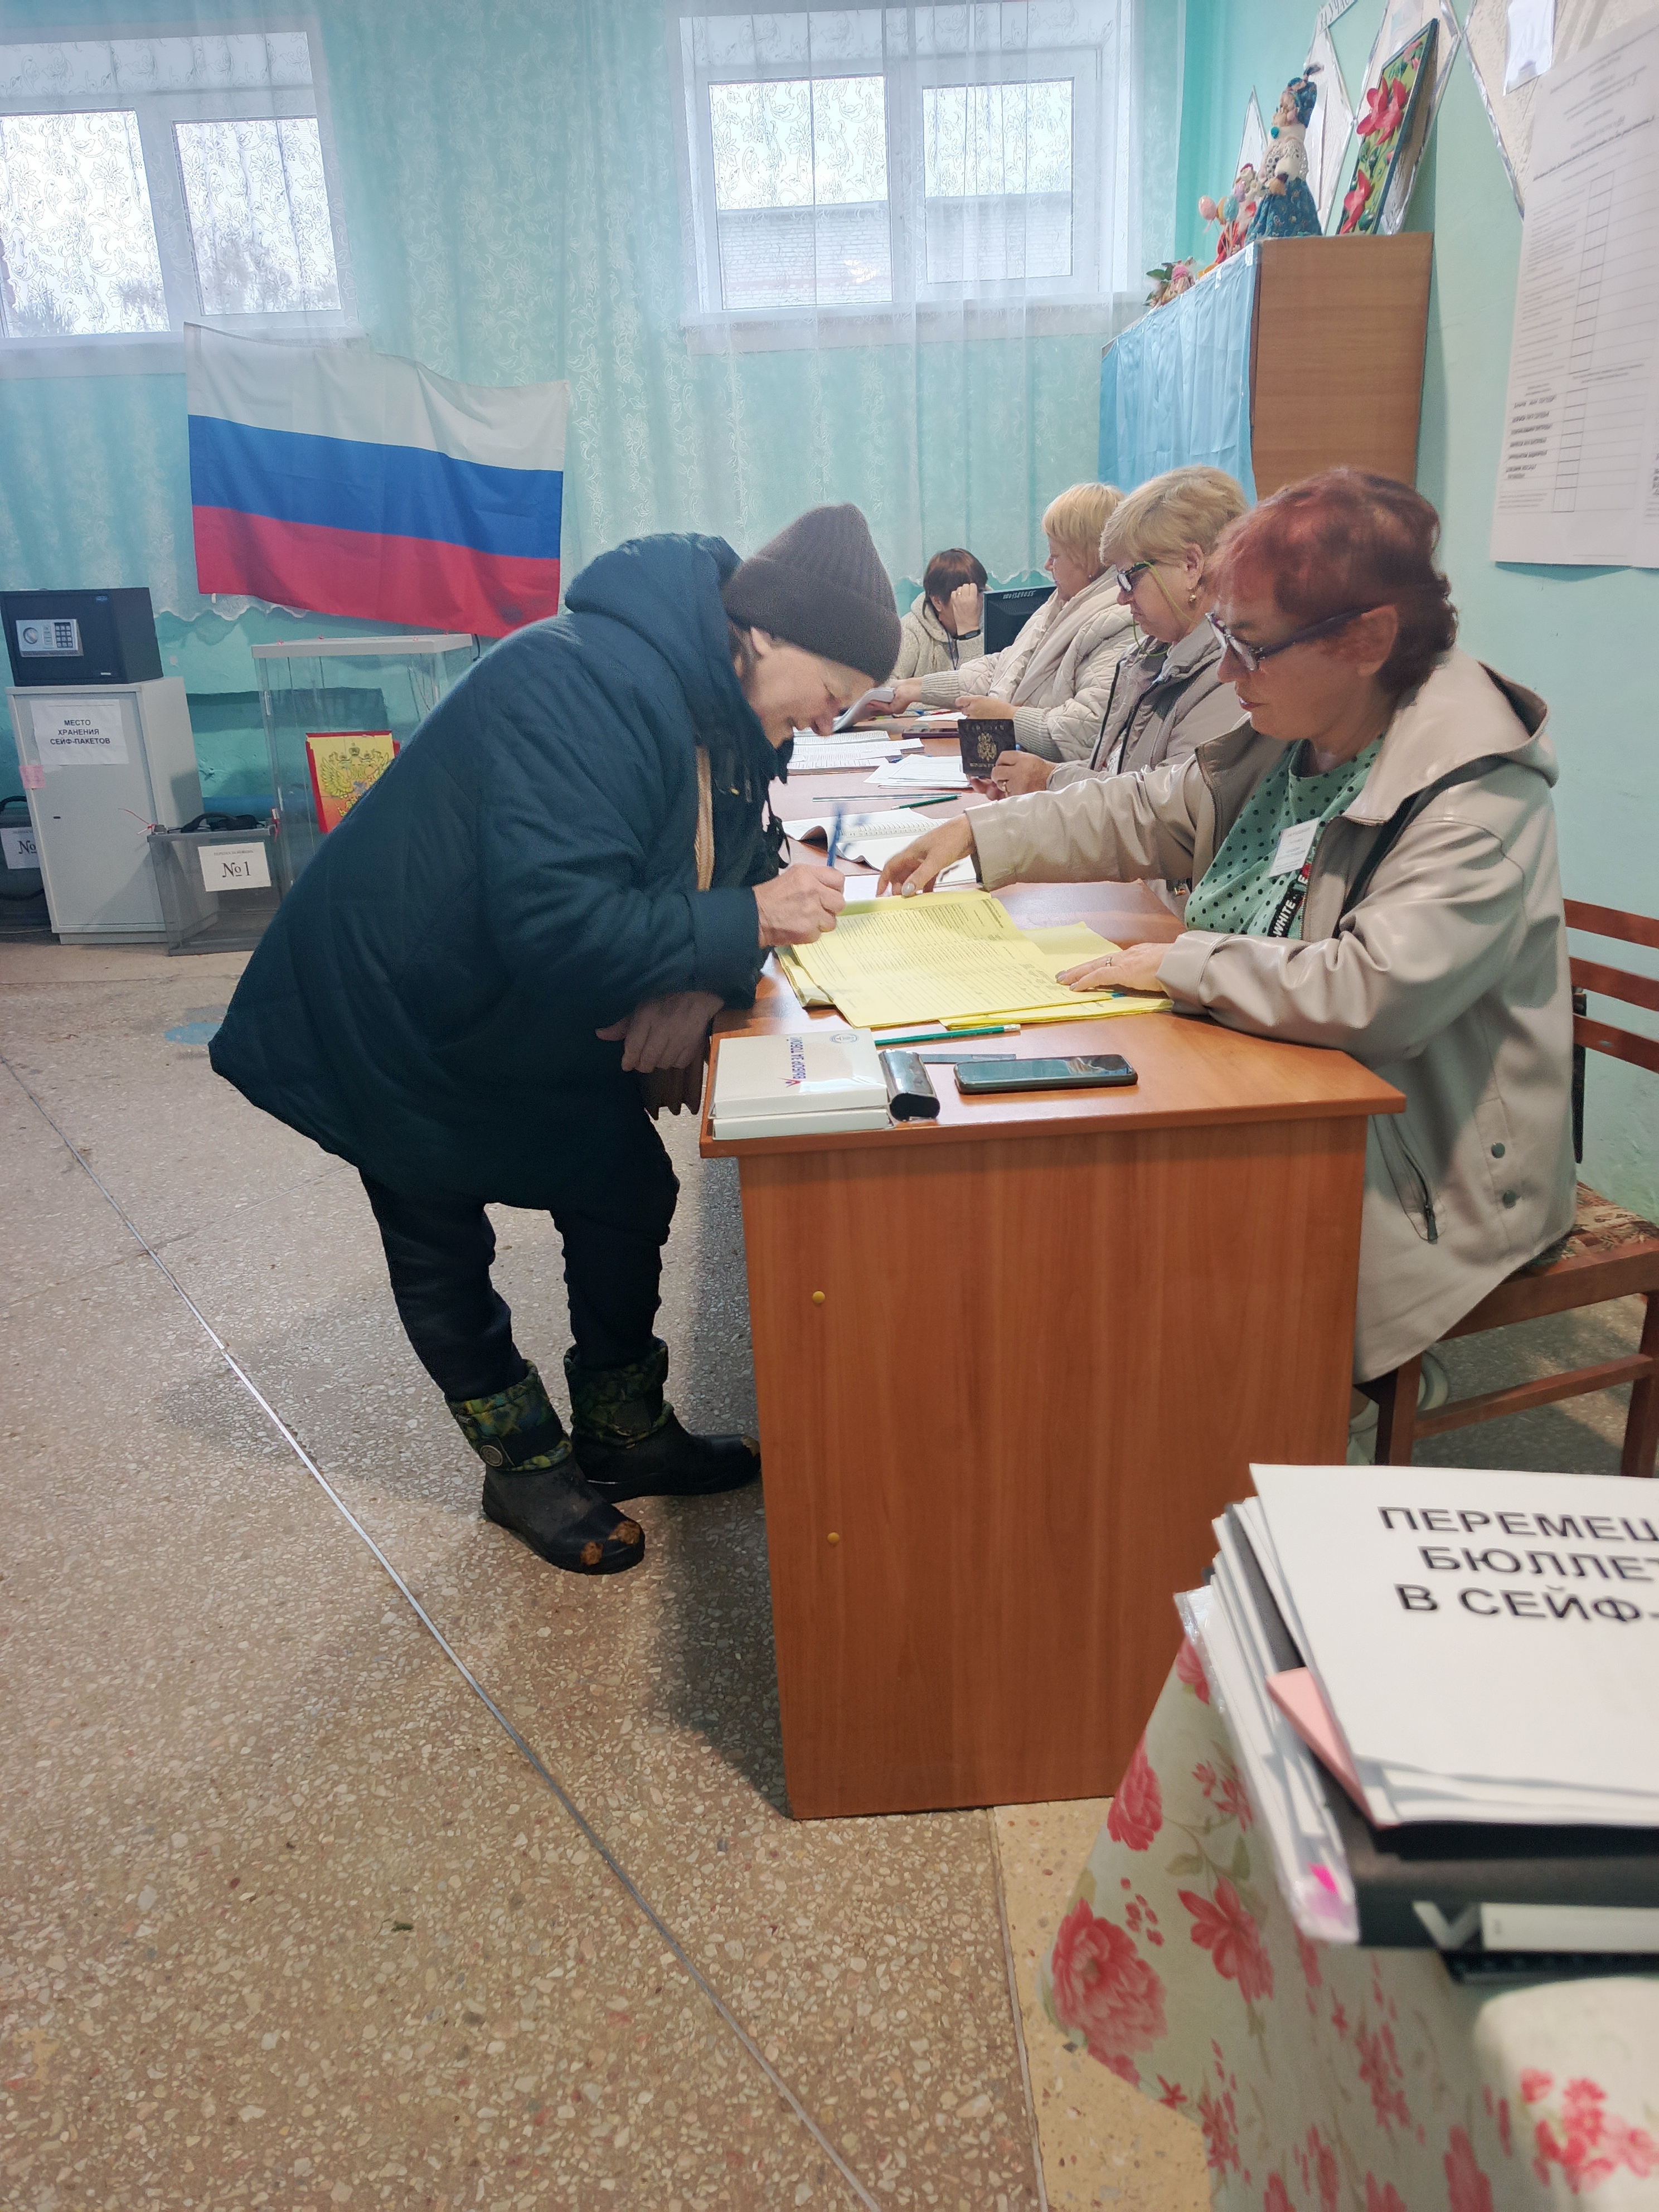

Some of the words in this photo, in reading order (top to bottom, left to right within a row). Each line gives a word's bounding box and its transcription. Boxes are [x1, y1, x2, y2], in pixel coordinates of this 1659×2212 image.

[792, 1061, 806, 1079] ВЫБОР
[1418, 1545, 1659, 1581] БЮЛЛЕ
[1394, 1583, 1438, 1611] В
